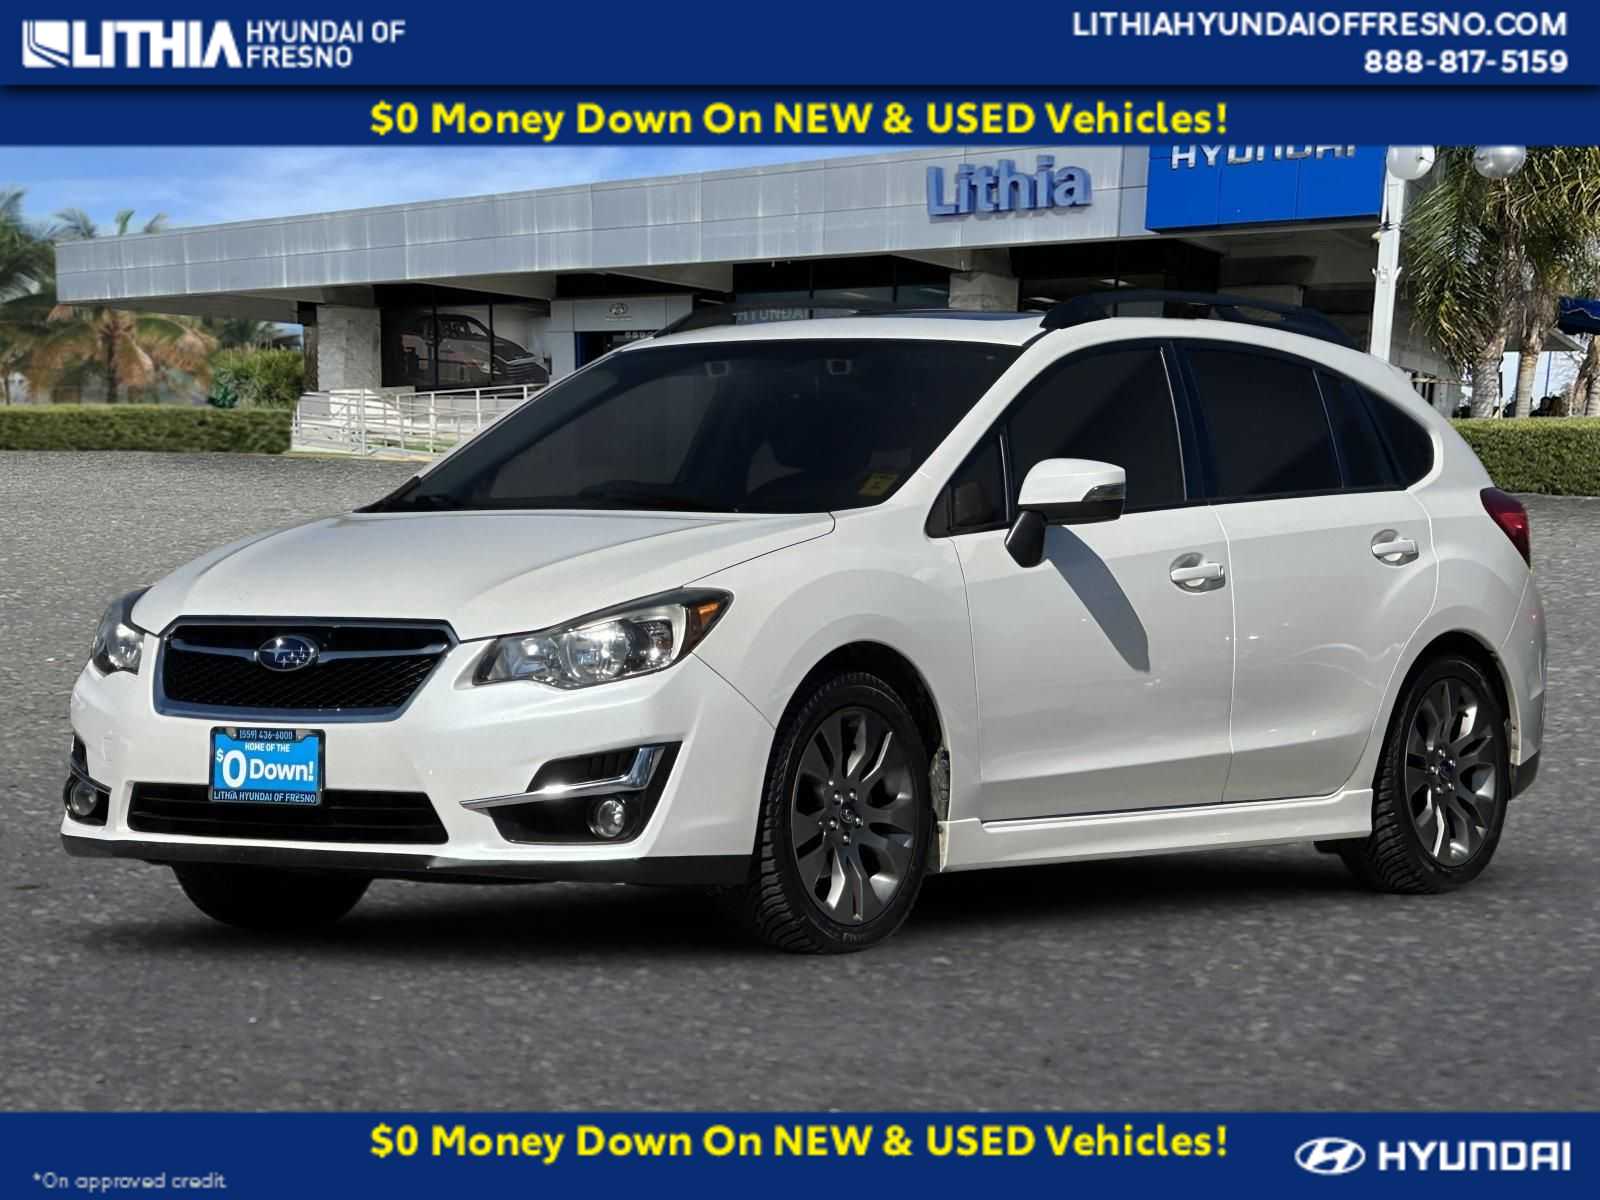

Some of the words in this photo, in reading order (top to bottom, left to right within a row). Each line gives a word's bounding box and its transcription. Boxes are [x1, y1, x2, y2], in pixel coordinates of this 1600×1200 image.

[927, 154, 1092, 219] Lithia
[245, 742, 265, 752] HOME
[266, 742, 276, 752] OF
[277, 743, 290, 753] THE
[249, 758, 314, 782] Down!
[213, 790, 238, 800] LITHIA
[239, 791, 272, 801] HYUNDAI
[273, 792, 284, 802] OF
[285, 792, 316, 803] FRESNO
